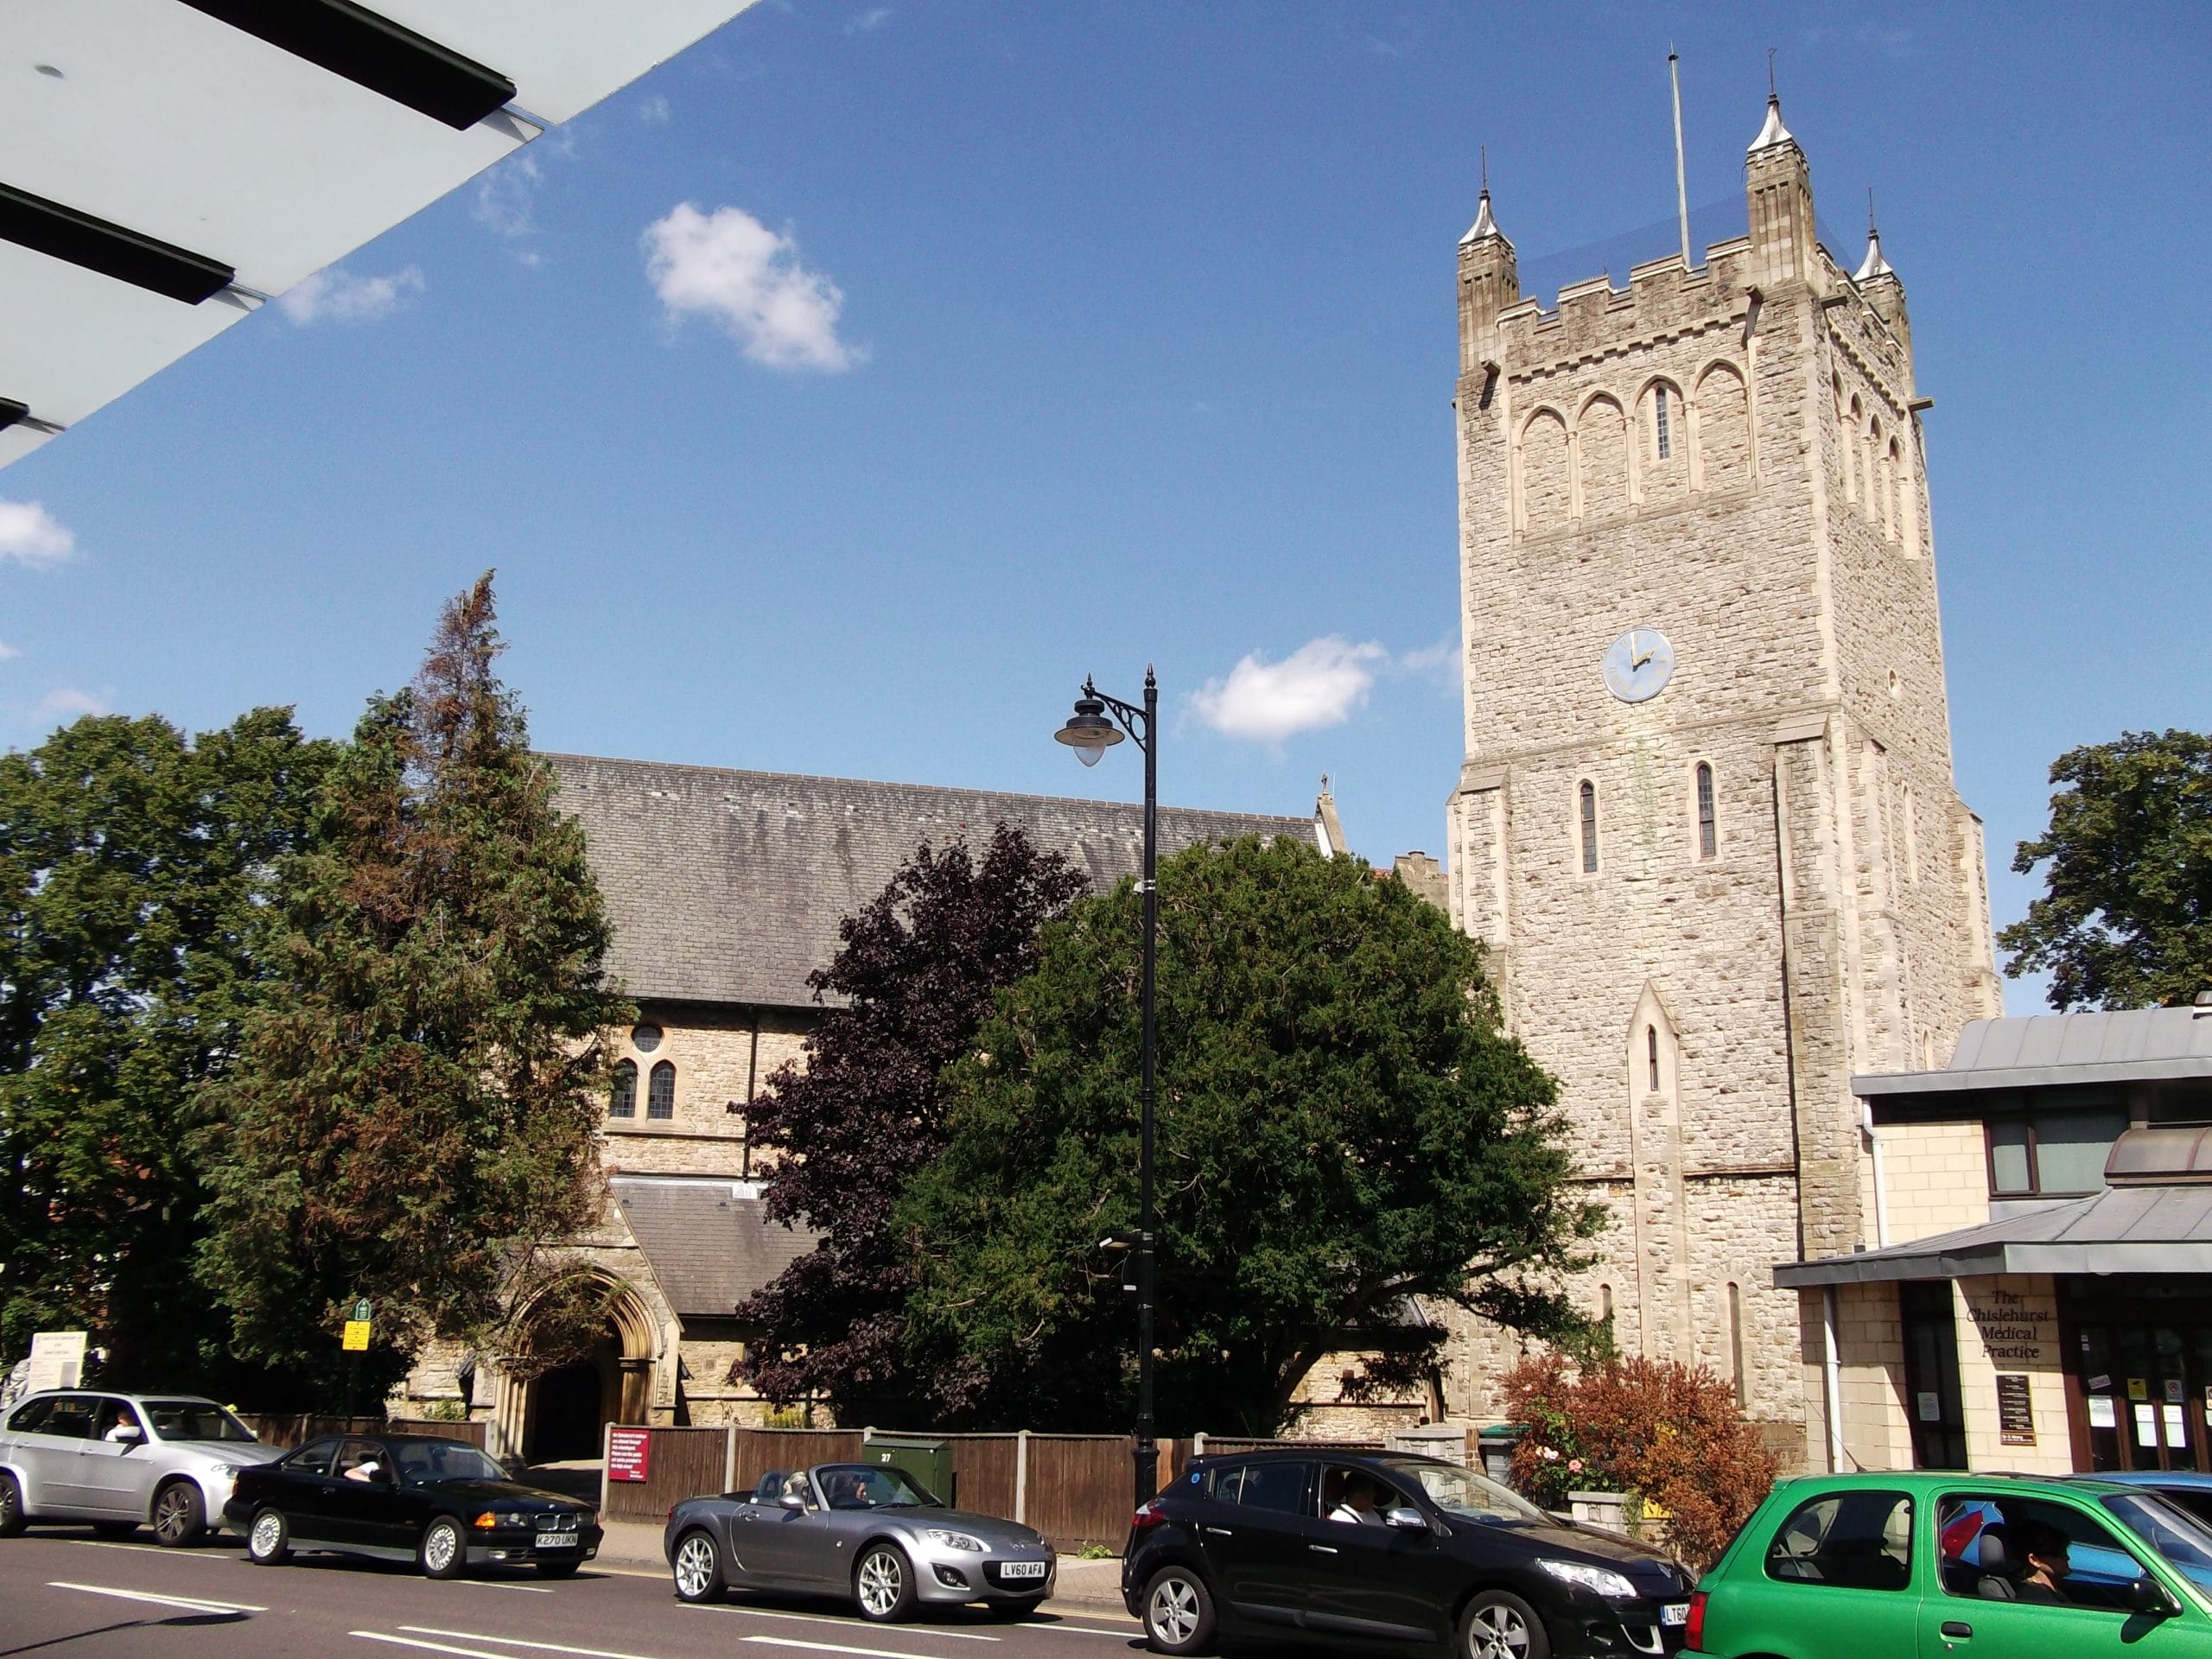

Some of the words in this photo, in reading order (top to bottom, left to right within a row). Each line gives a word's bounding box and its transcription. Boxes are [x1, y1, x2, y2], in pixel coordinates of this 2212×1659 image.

[1992, 1290, 2019, 1304] The
[1967, 1307, 2049, 1322] Chislehurst
[1981, 1325, 2037, 1340] Medical
[1981, 1344, 2039, 1358] Practice
[881, 1452, 891, 1462] 27
[537, 1535, 561, 1545] K270
[1004, 1564, 1027, 1575] LV60
[1028, 1564, 1042, 1575] AFA
